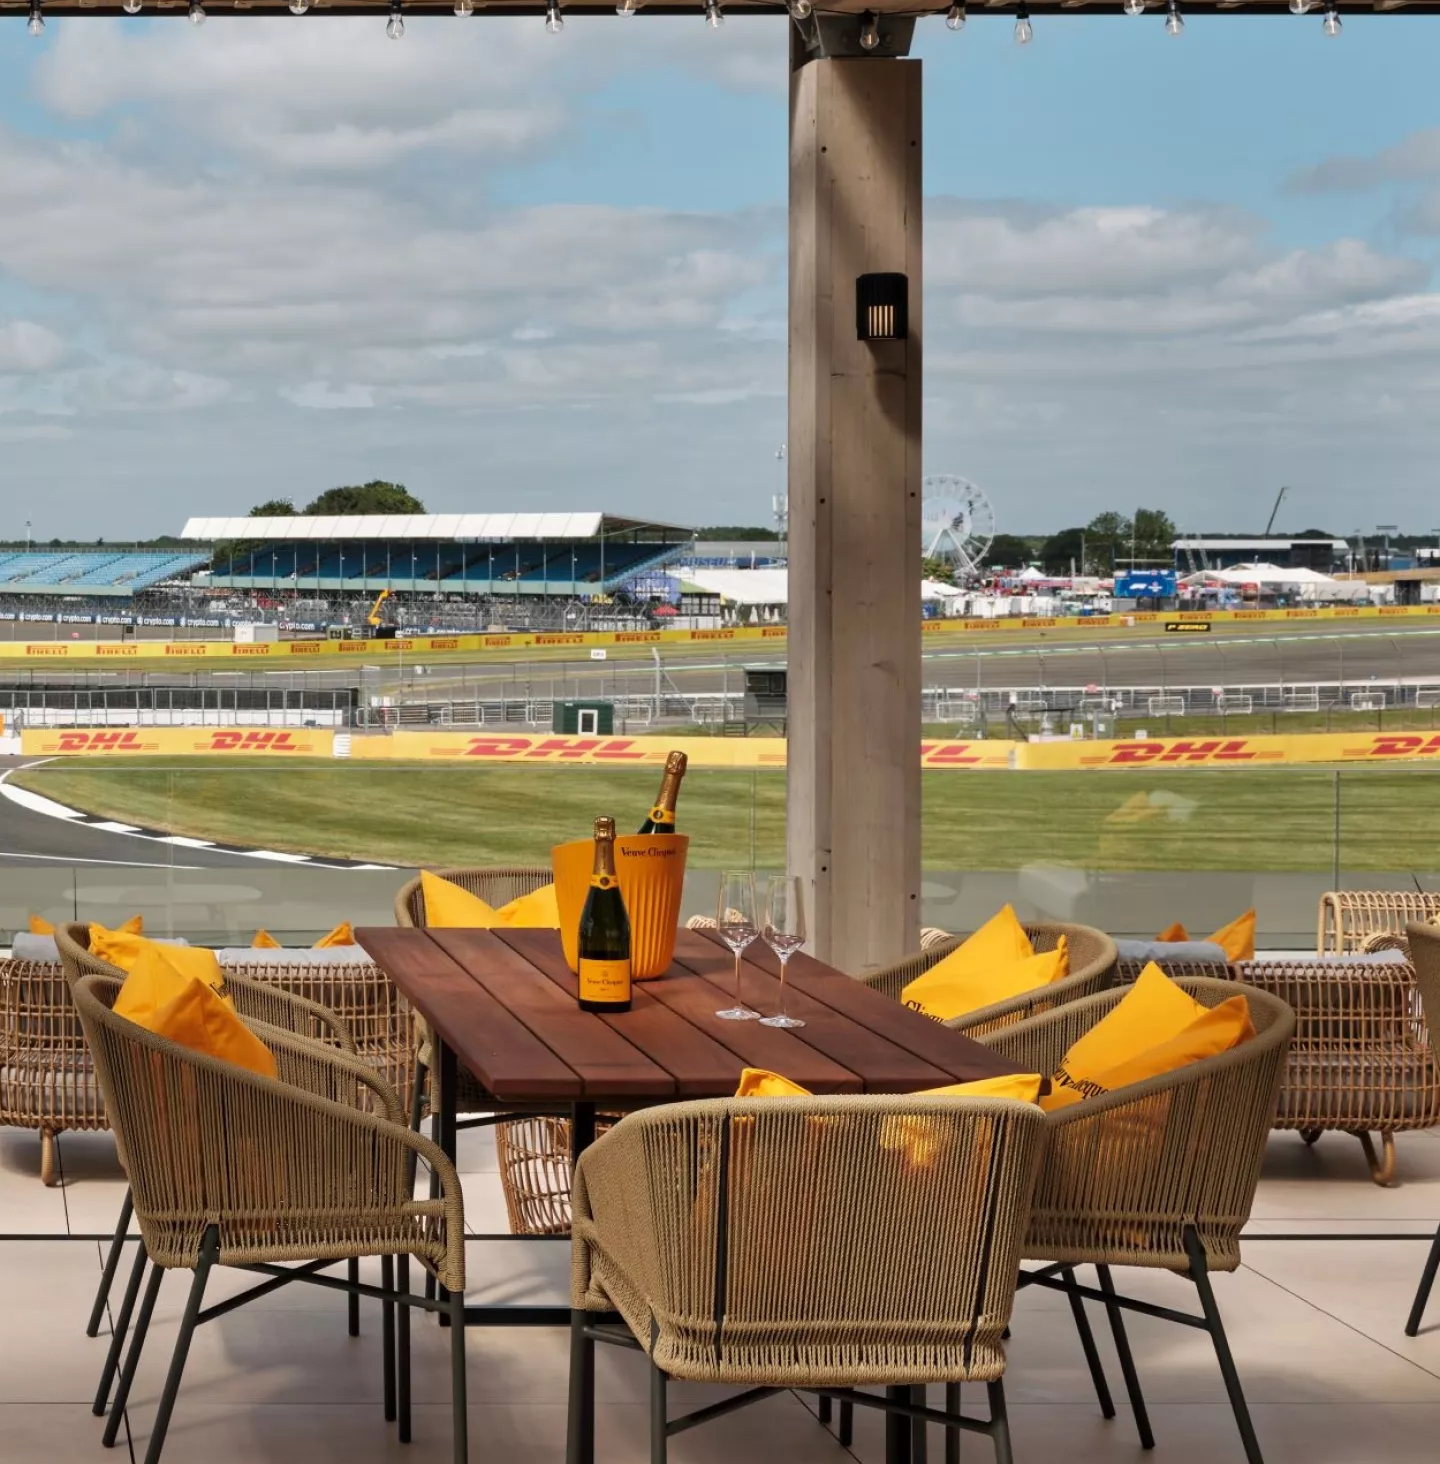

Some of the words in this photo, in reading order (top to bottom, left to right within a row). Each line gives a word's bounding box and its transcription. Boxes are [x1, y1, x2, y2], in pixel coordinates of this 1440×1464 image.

[103, 616, 132, 624] crypto.com
[144, 618, 175, 626] crypto.com
[535, 634, 584, 644] PIRELLI
[615, 632, 660, 643] PIRELLI
[690, 630, 735, 640] PIRELLI
[384, 640, 413, 650] PIRELLI
[430, 640, 458, 650] PIRELLI
[486, 636, 510, 646] PIRELLI
[26, 645, 68, 655] PIRELLI
[96, 645, 138, 655] PIRELLI
[165, 645, 206, 655] PIRELLI
[232, 644, 270, 655] PIRELLI
[290, 642, 320, 654] PIRELLI
[338, 642, 366, 652] PIRELLI
[58, 732, 142, 750] DHL
[209, 732, 297, 750] DHL
[463, 739, 647, 758] DHL
[1109, 741, 1258, 762] DHL
[621, 847, 646, 857] Veuve
